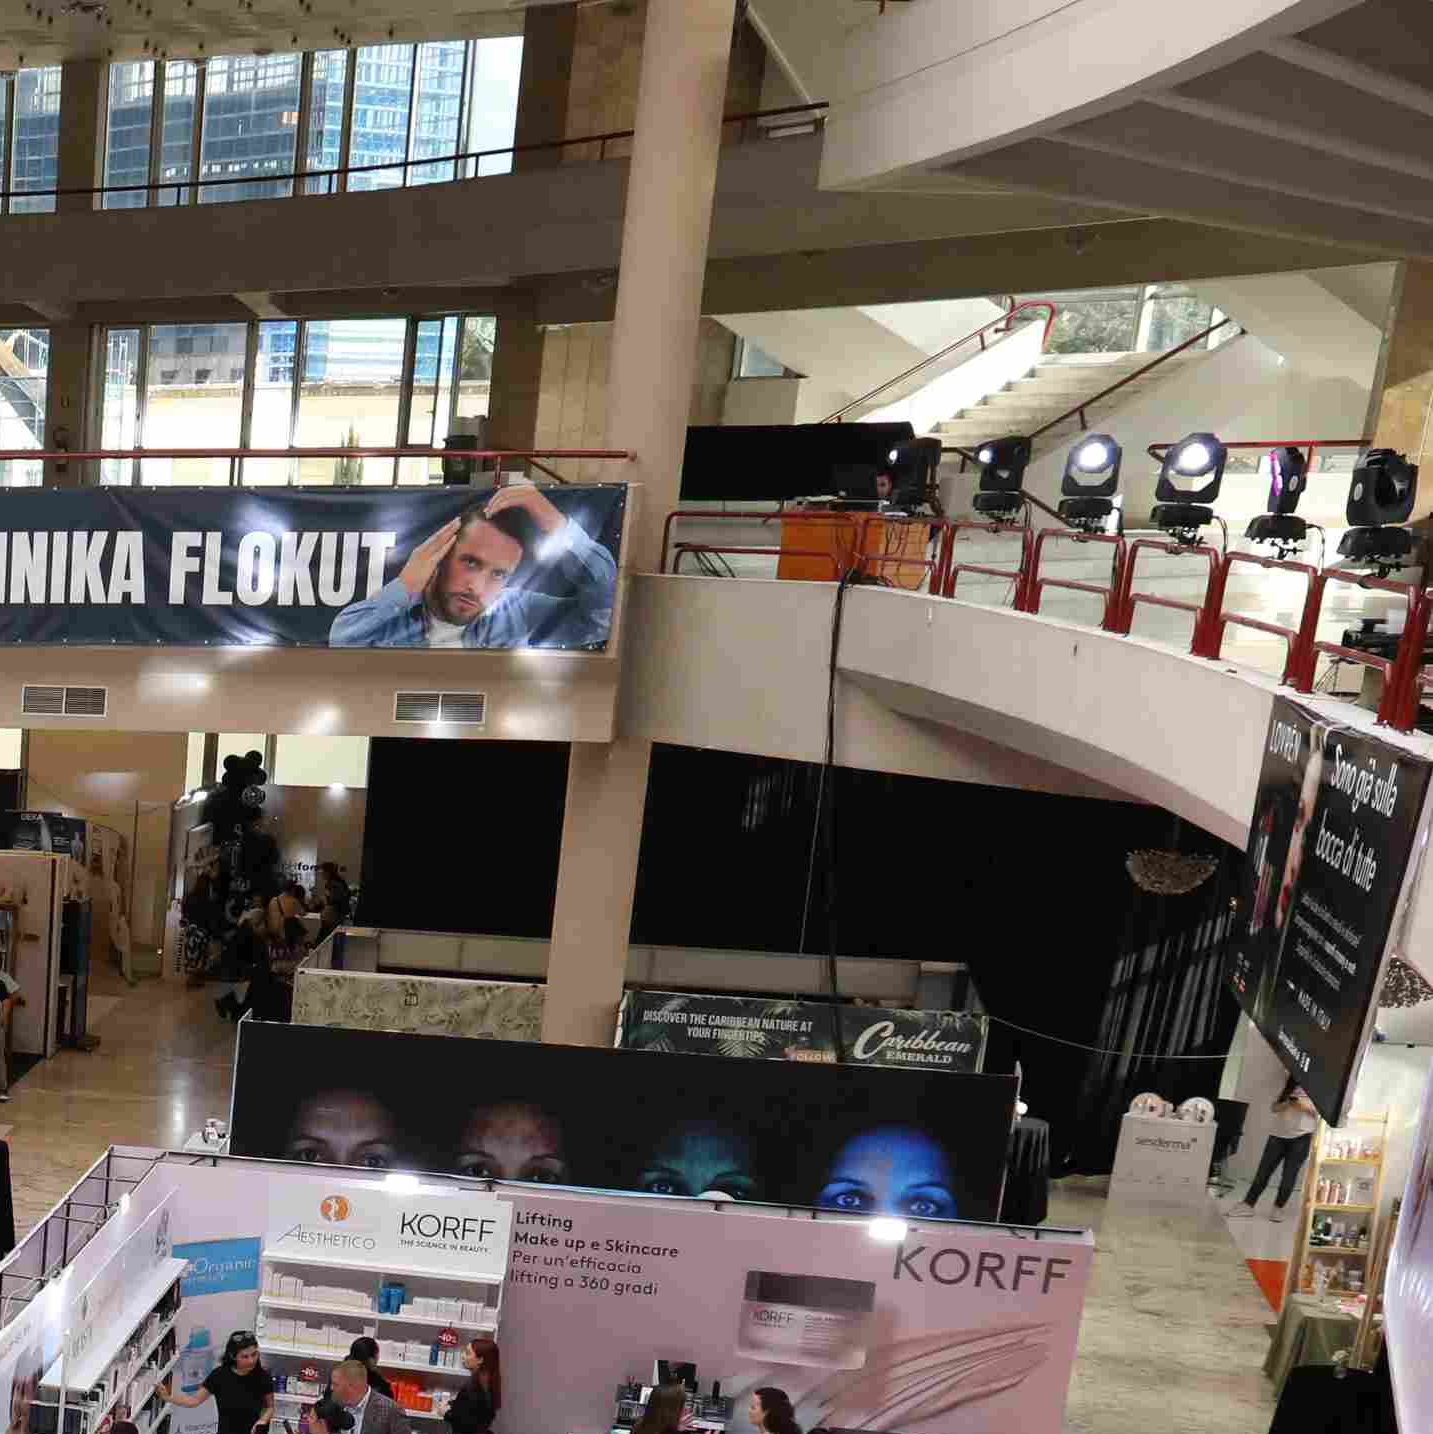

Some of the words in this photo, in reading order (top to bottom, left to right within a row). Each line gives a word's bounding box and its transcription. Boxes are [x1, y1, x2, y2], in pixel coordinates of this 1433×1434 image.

[169, 529, 396, 606] FLOKUT
[1331, 743, 1359, 795] Sono
[1370, 763, 1399, 818] sulla
[1315, 808, 1345, 871] bocca
[643, 1009, 687, 1025] DISCOVER
[689, 1012, 707, 1026] THE
[708, 1014, 761, 1030] CARIBBEAN
[761, 1017, 799, 1032] NATURE
[799, 1020, 813, 1033] AT
[687, 1026, 711, 1039] YOUR
[853, 1019, 972, 1060] Caribbean
[885, 1052, 953, 1065] EMERALD
[1133, 1134, 1191, 1151] sesderma
[400, 1211, 498, 1242] KORFF
[516, 1211, 574, 1233] Lifting
[277, 1222, 376, 1251] AESTHETICO
[400, 1239, 414, 1247] THE
[414, 1240, 449, 1250] SCIENCE
[514, 1231, 560, 1249] Make
[564, 1237, 587, 1252] up
[591, 1239, 602, 1250] e
[605, 1239, 680, 1259] Skincare
[512, 1250, 539, 1265] Per
[892, 1244, 1073, 1295] KORFF
[510, 1268, 559, 1290] lifting
[564, 1278, 574, 1288] a
[579, 1275, 609, 1292] 360
[613, 1277, 659, 1298] gradi
